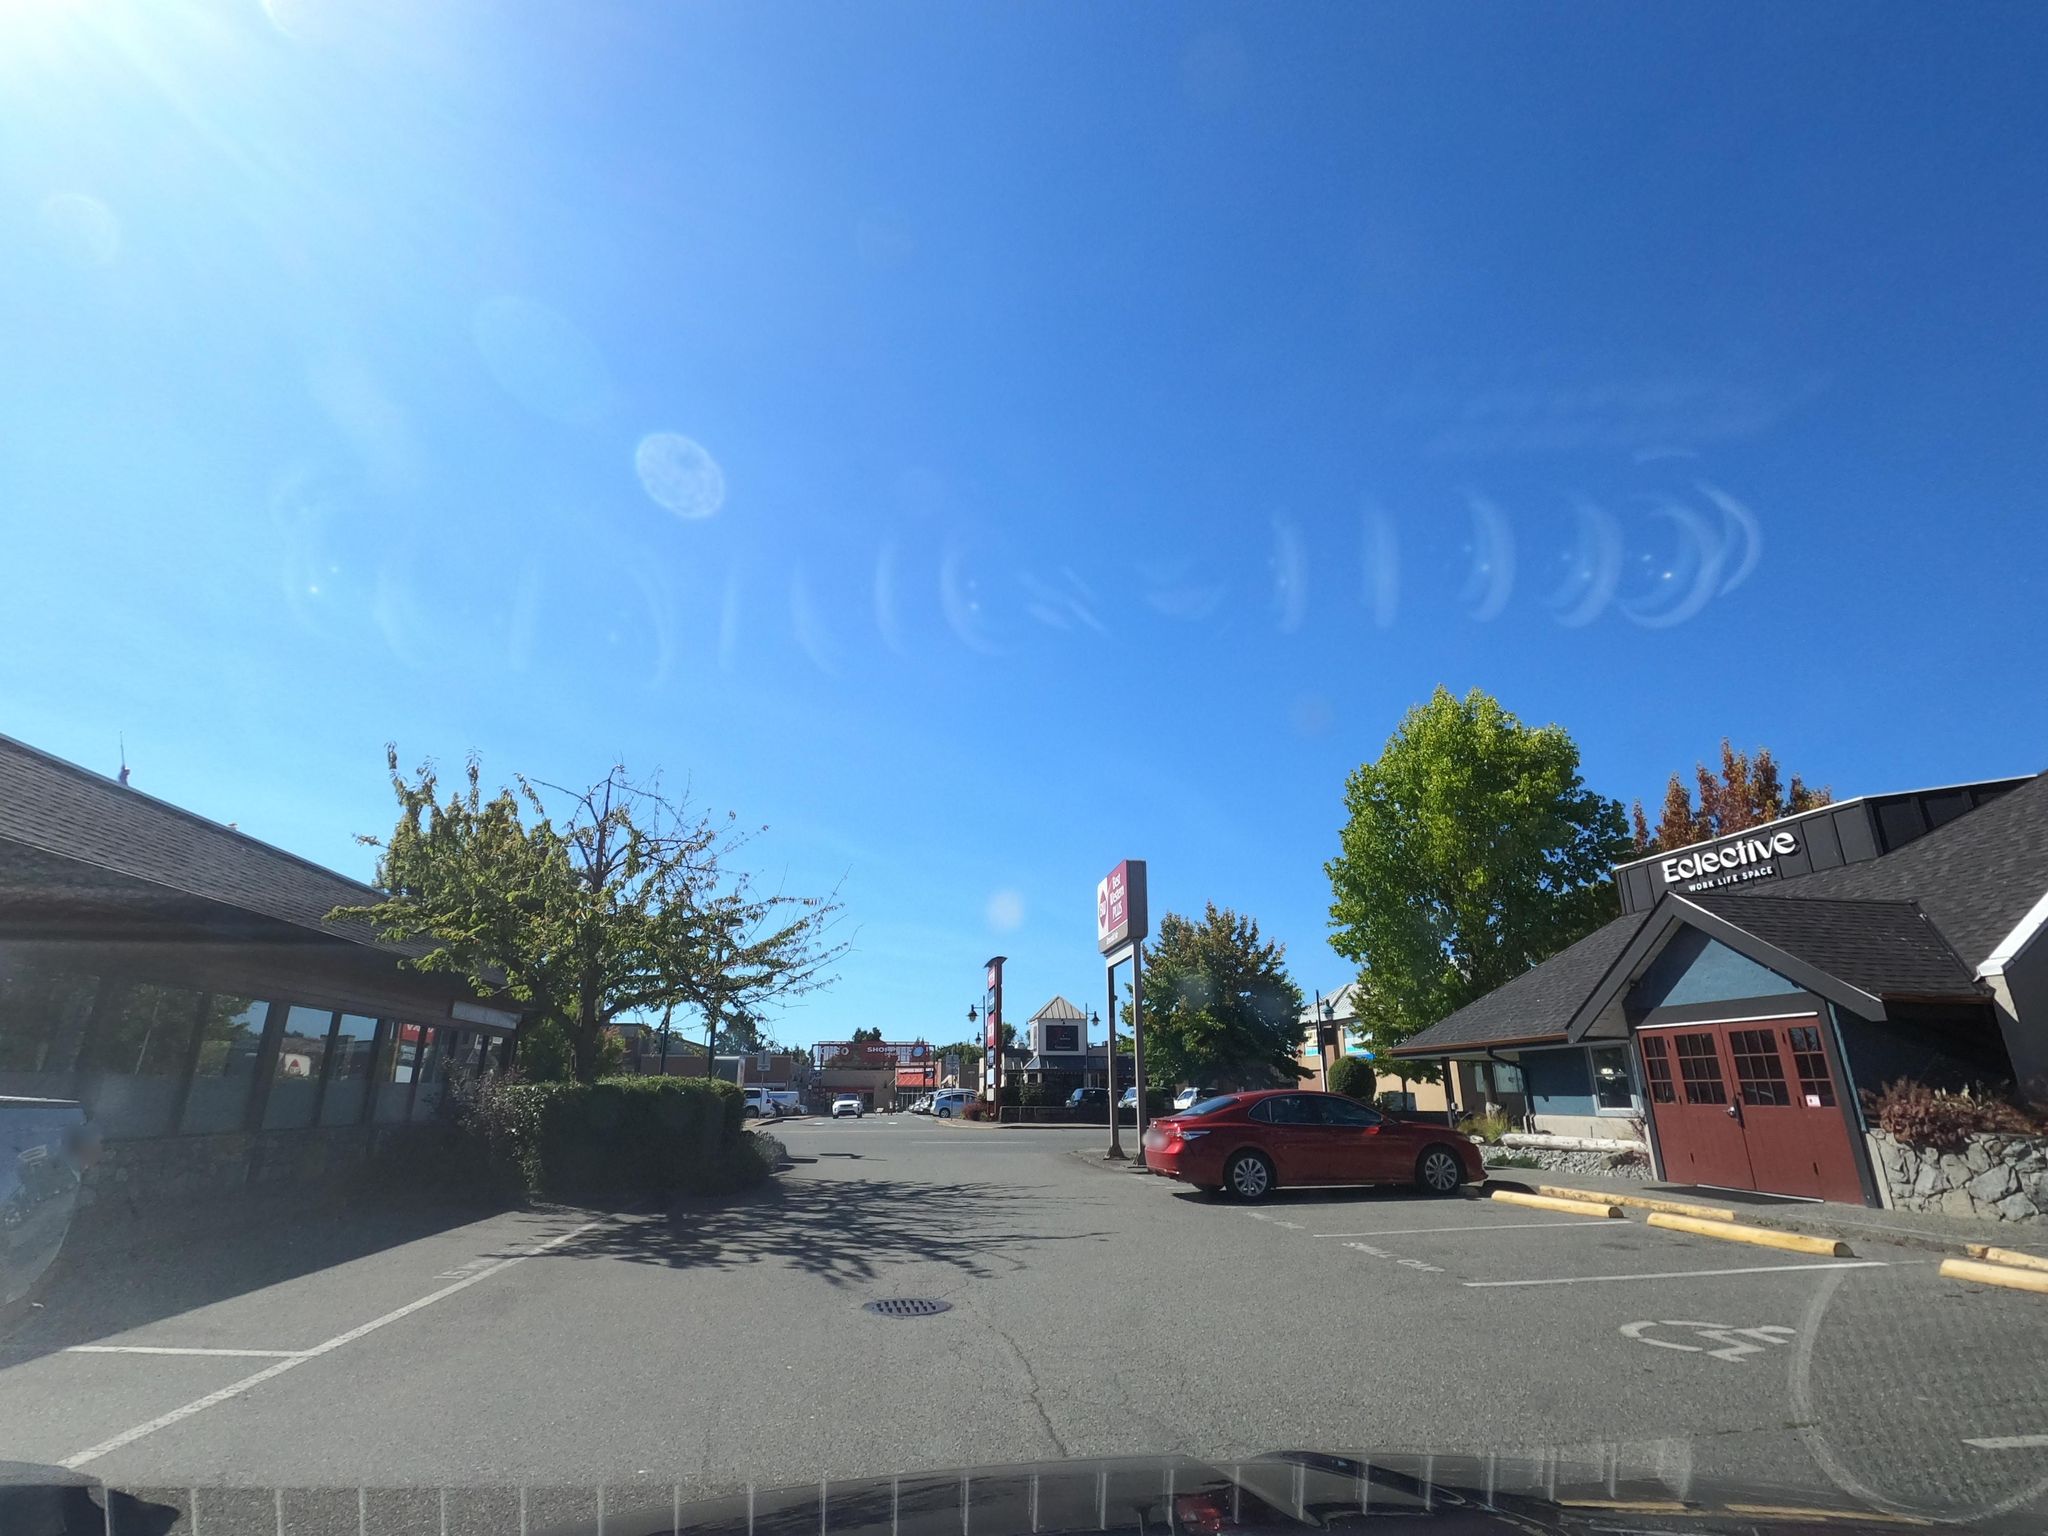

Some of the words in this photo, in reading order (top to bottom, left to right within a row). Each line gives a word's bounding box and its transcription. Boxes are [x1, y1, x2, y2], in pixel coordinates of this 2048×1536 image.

[1661, 832, 1796, 883] Eclective
[1688, 882, 1715, 892] WORK
[1717, 874, 1738, 886] LIFE
[1742, 866, 1773, 880] SPACE
